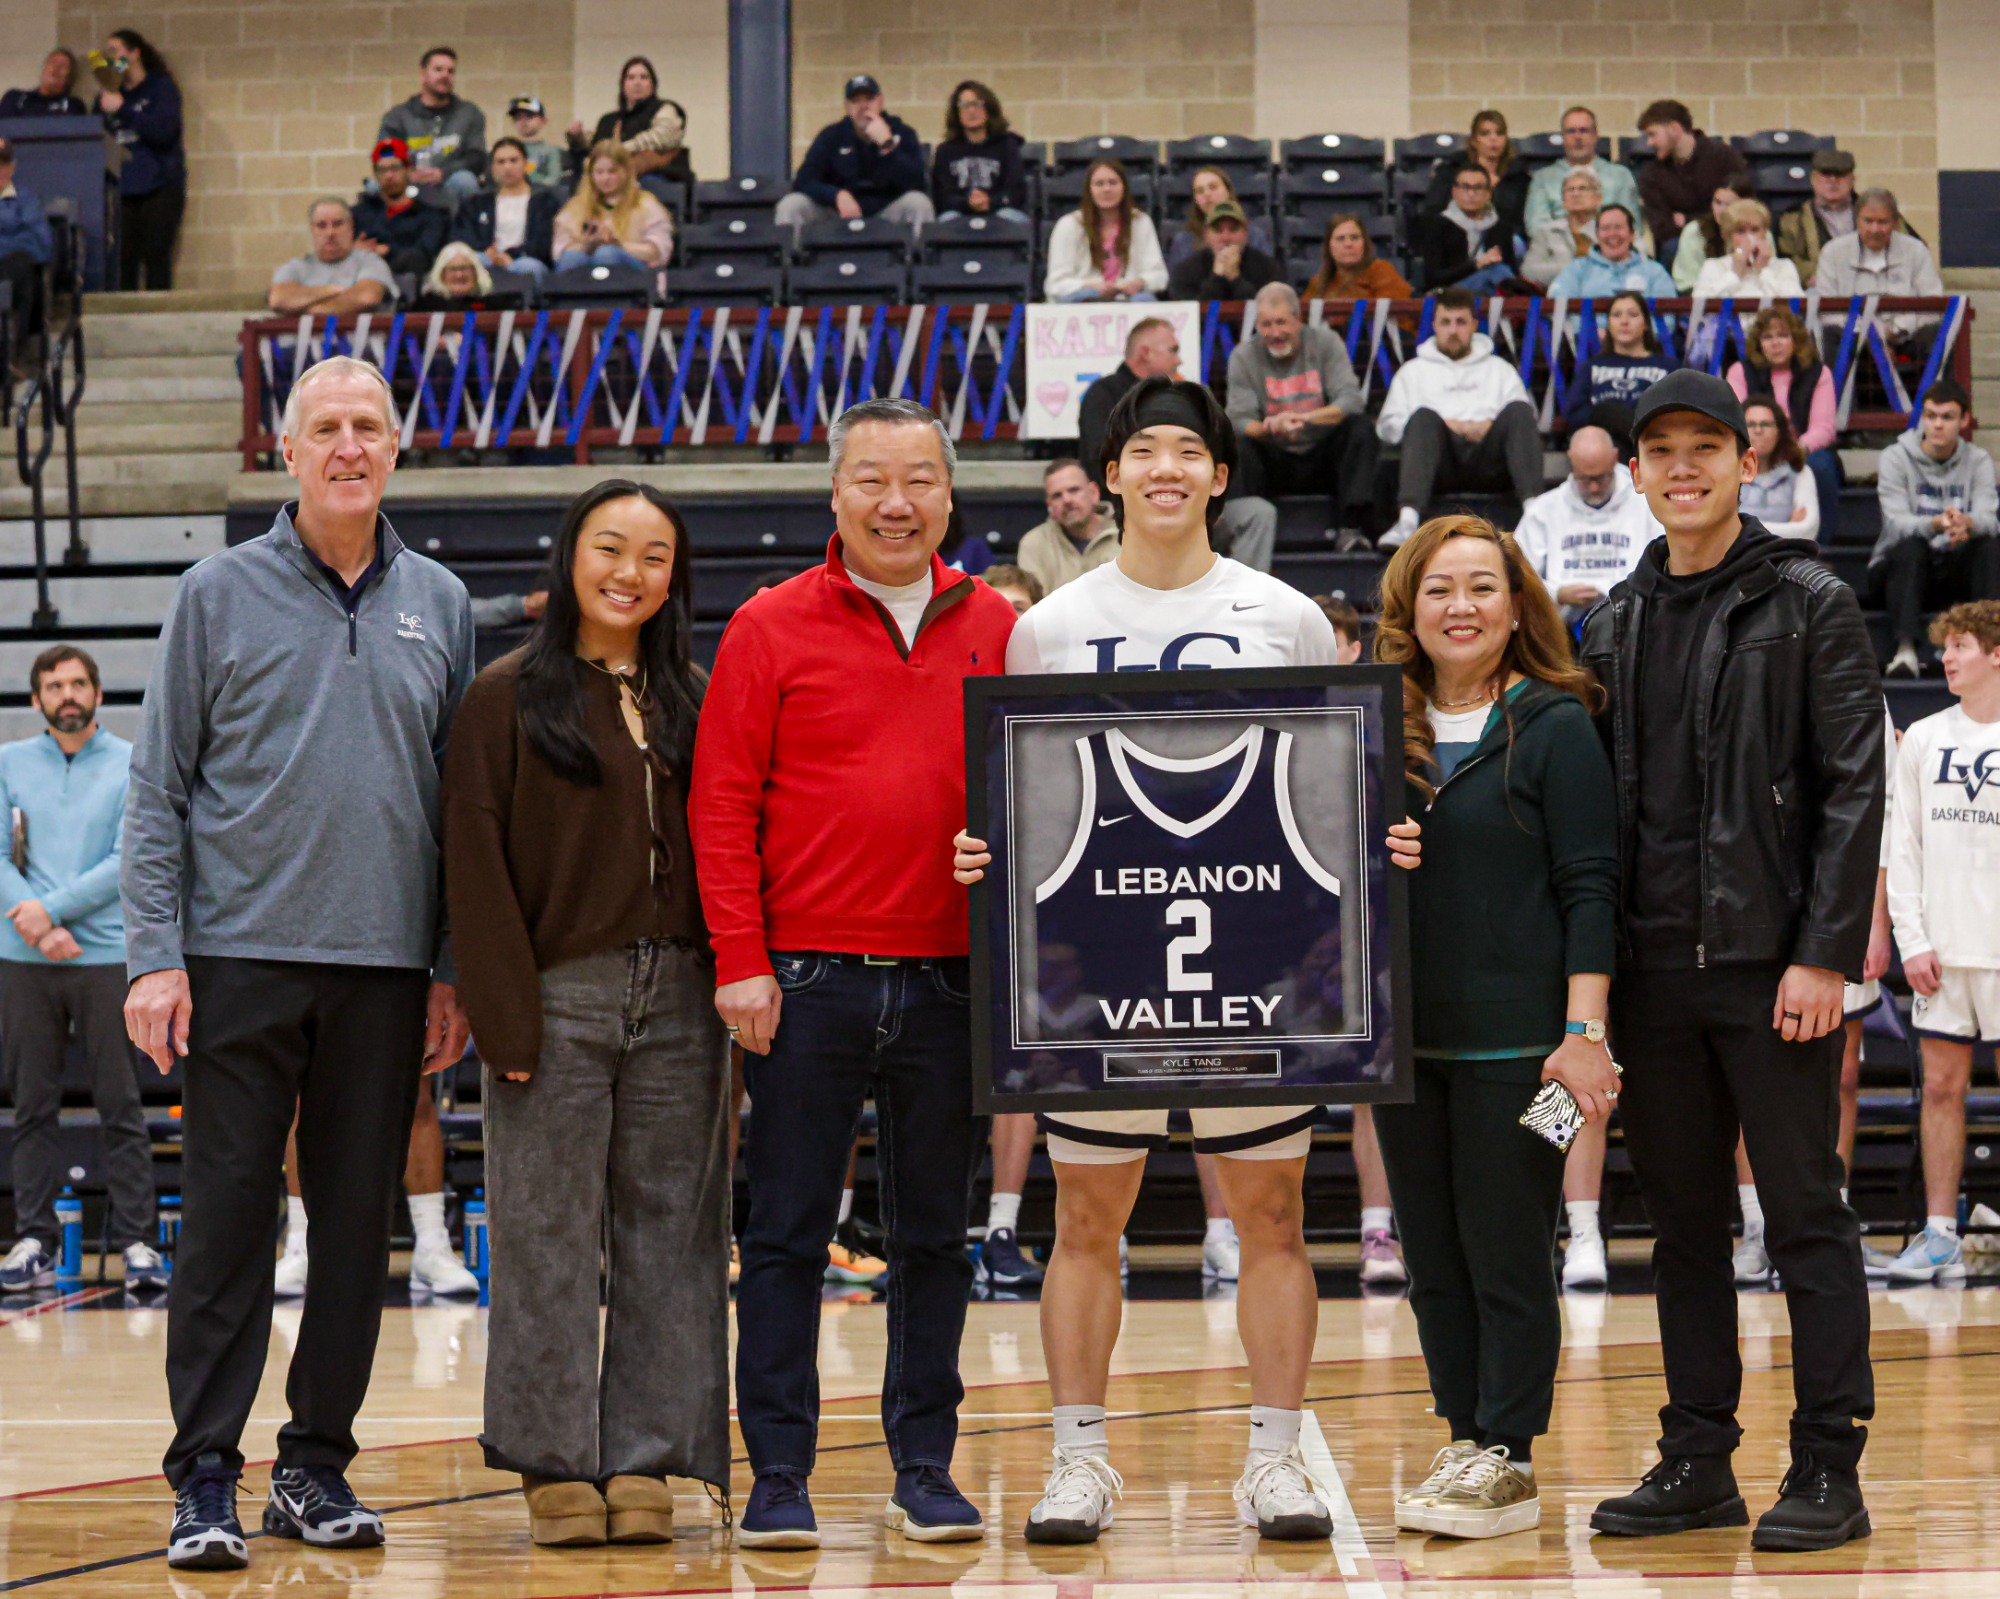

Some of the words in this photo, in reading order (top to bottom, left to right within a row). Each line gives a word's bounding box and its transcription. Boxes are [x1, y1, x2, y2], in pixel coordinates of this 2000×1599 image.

[1035, 312, 1189, 359] KAILY
[398, 612, 422, 631] LVC
[1095, 864, 1281, 896] LEBANON
[1165, 899, 1213, 992] 2
[1098, 995, 1283, 1030] VALLEY
[1162, 1059, 1190, 1067] KYLE
[1192, 1058, 1222, 1067] TANG
